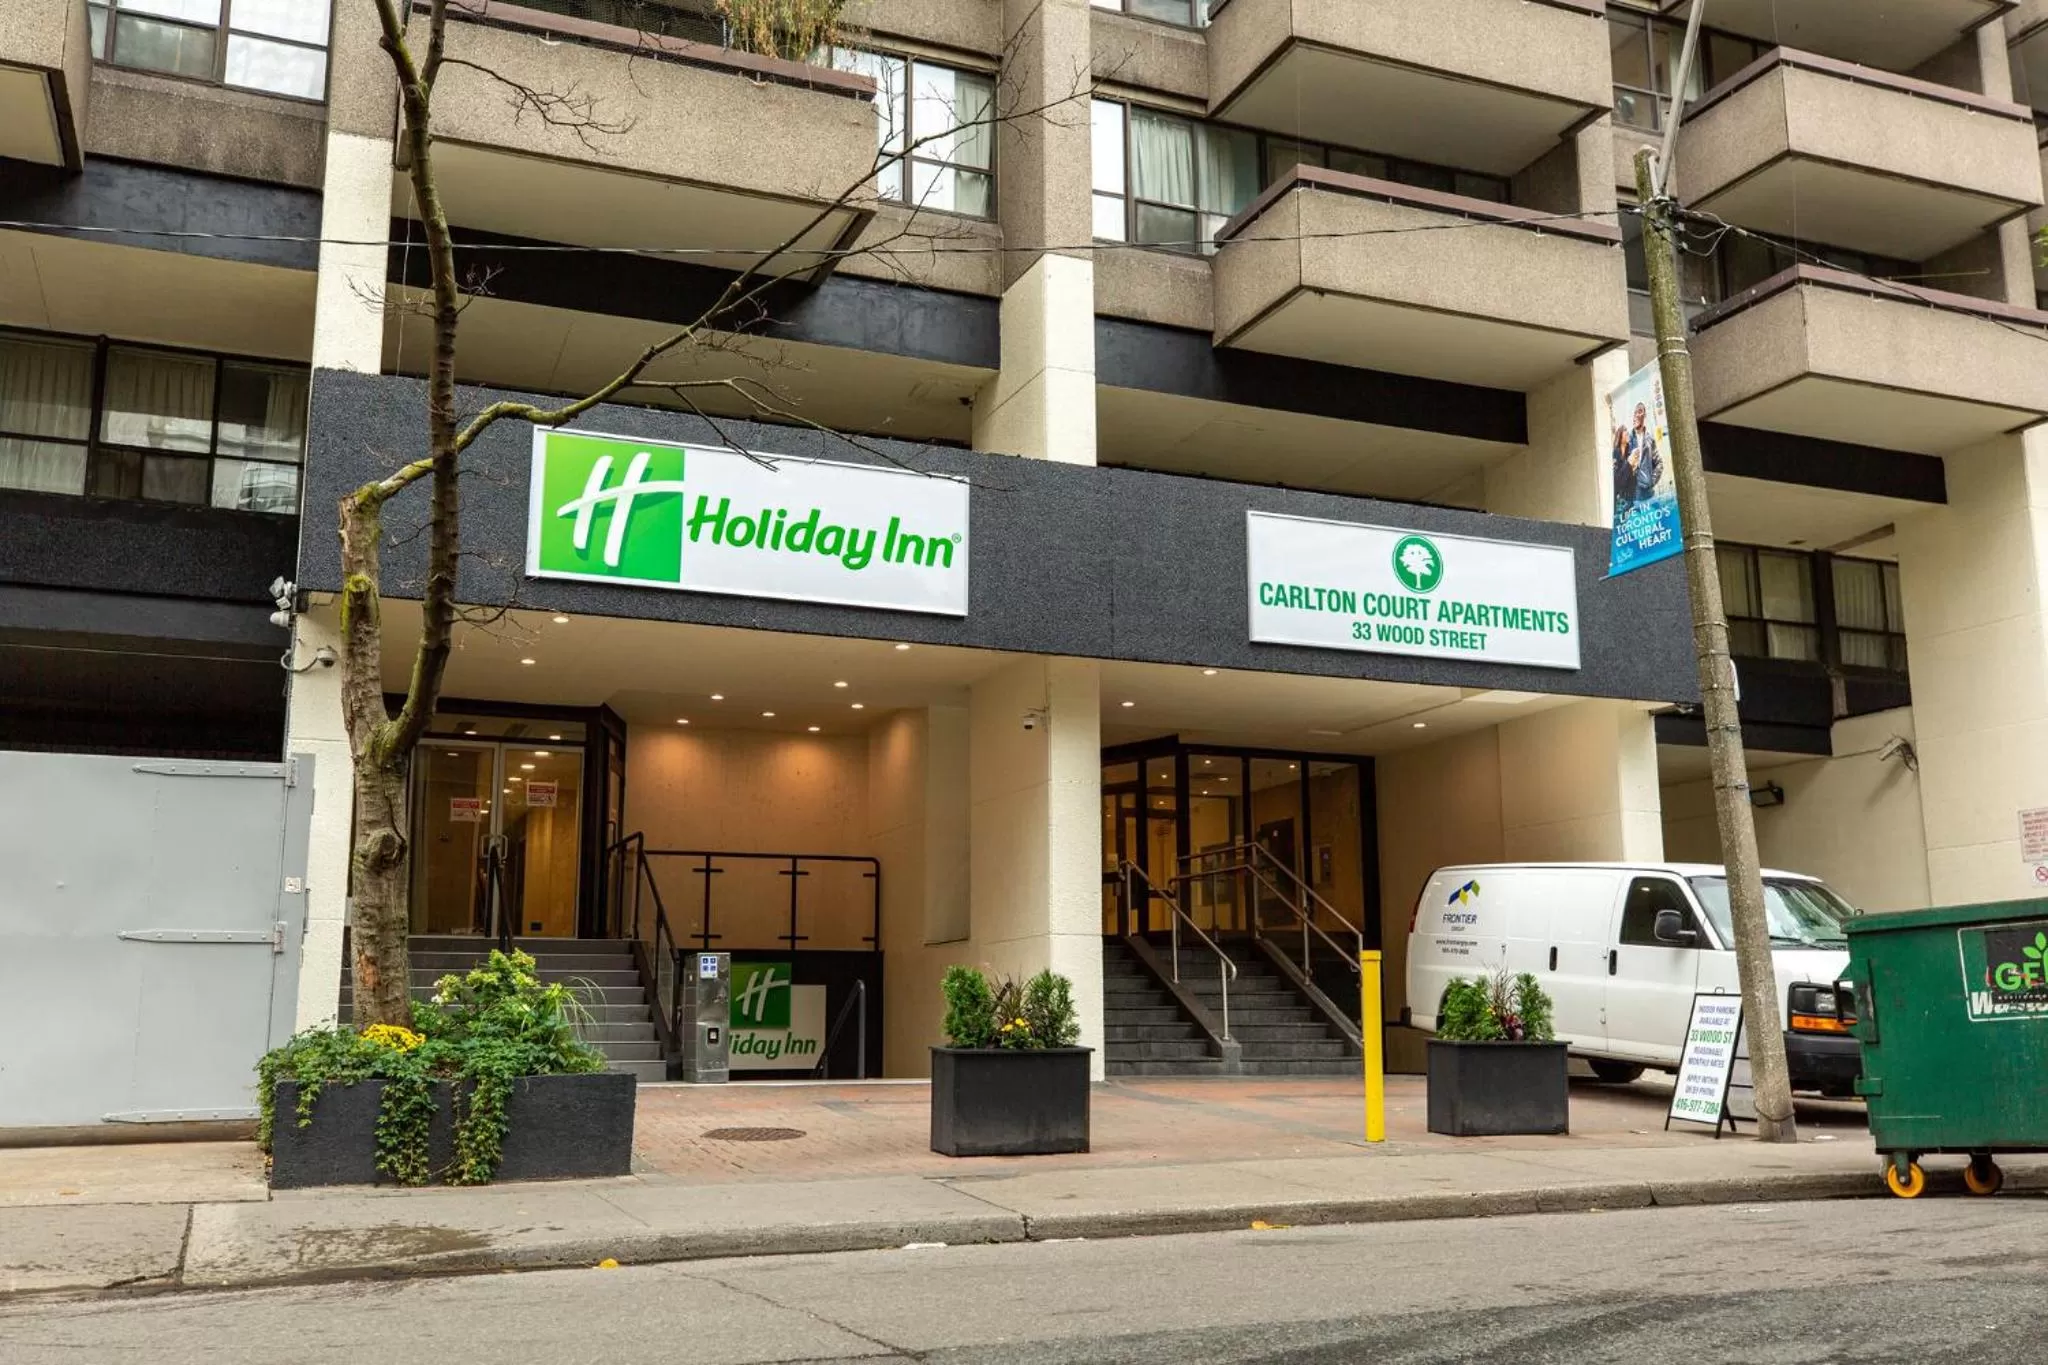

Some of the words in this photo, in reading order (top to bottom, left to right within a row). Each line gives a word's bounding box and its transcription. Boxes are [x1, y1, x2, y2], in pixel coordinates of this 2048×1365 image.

[1639, 502, 1650, 513] IN
[1616, 505, 1671, 535] TORONTO'S
[686, 495, 878, 570] Holiday
[1616, 521, 1664, 547] CULTURAL
[1639, 528, 1672, 550] HEART
[1259, 582, 1357, 615] CARLTON
[1363, 592, 1431, 621] COURT
[1437, 600, 1570, 635] APARTMENTS
[1352, 622, 1372, 640] 33
[1376, 624, 1425, 646] WOOD
[1430, 630, 1487, 651] STREET
[1442, 914, 1478, 924] FRONTIER
[784, 1031, 816, 1054] Inn
[1690, 1029, 1699, 1042] 33
[1700, 1029, 1722, 1043] WOOD
[1722, 1031, 1734, 1044] ST
